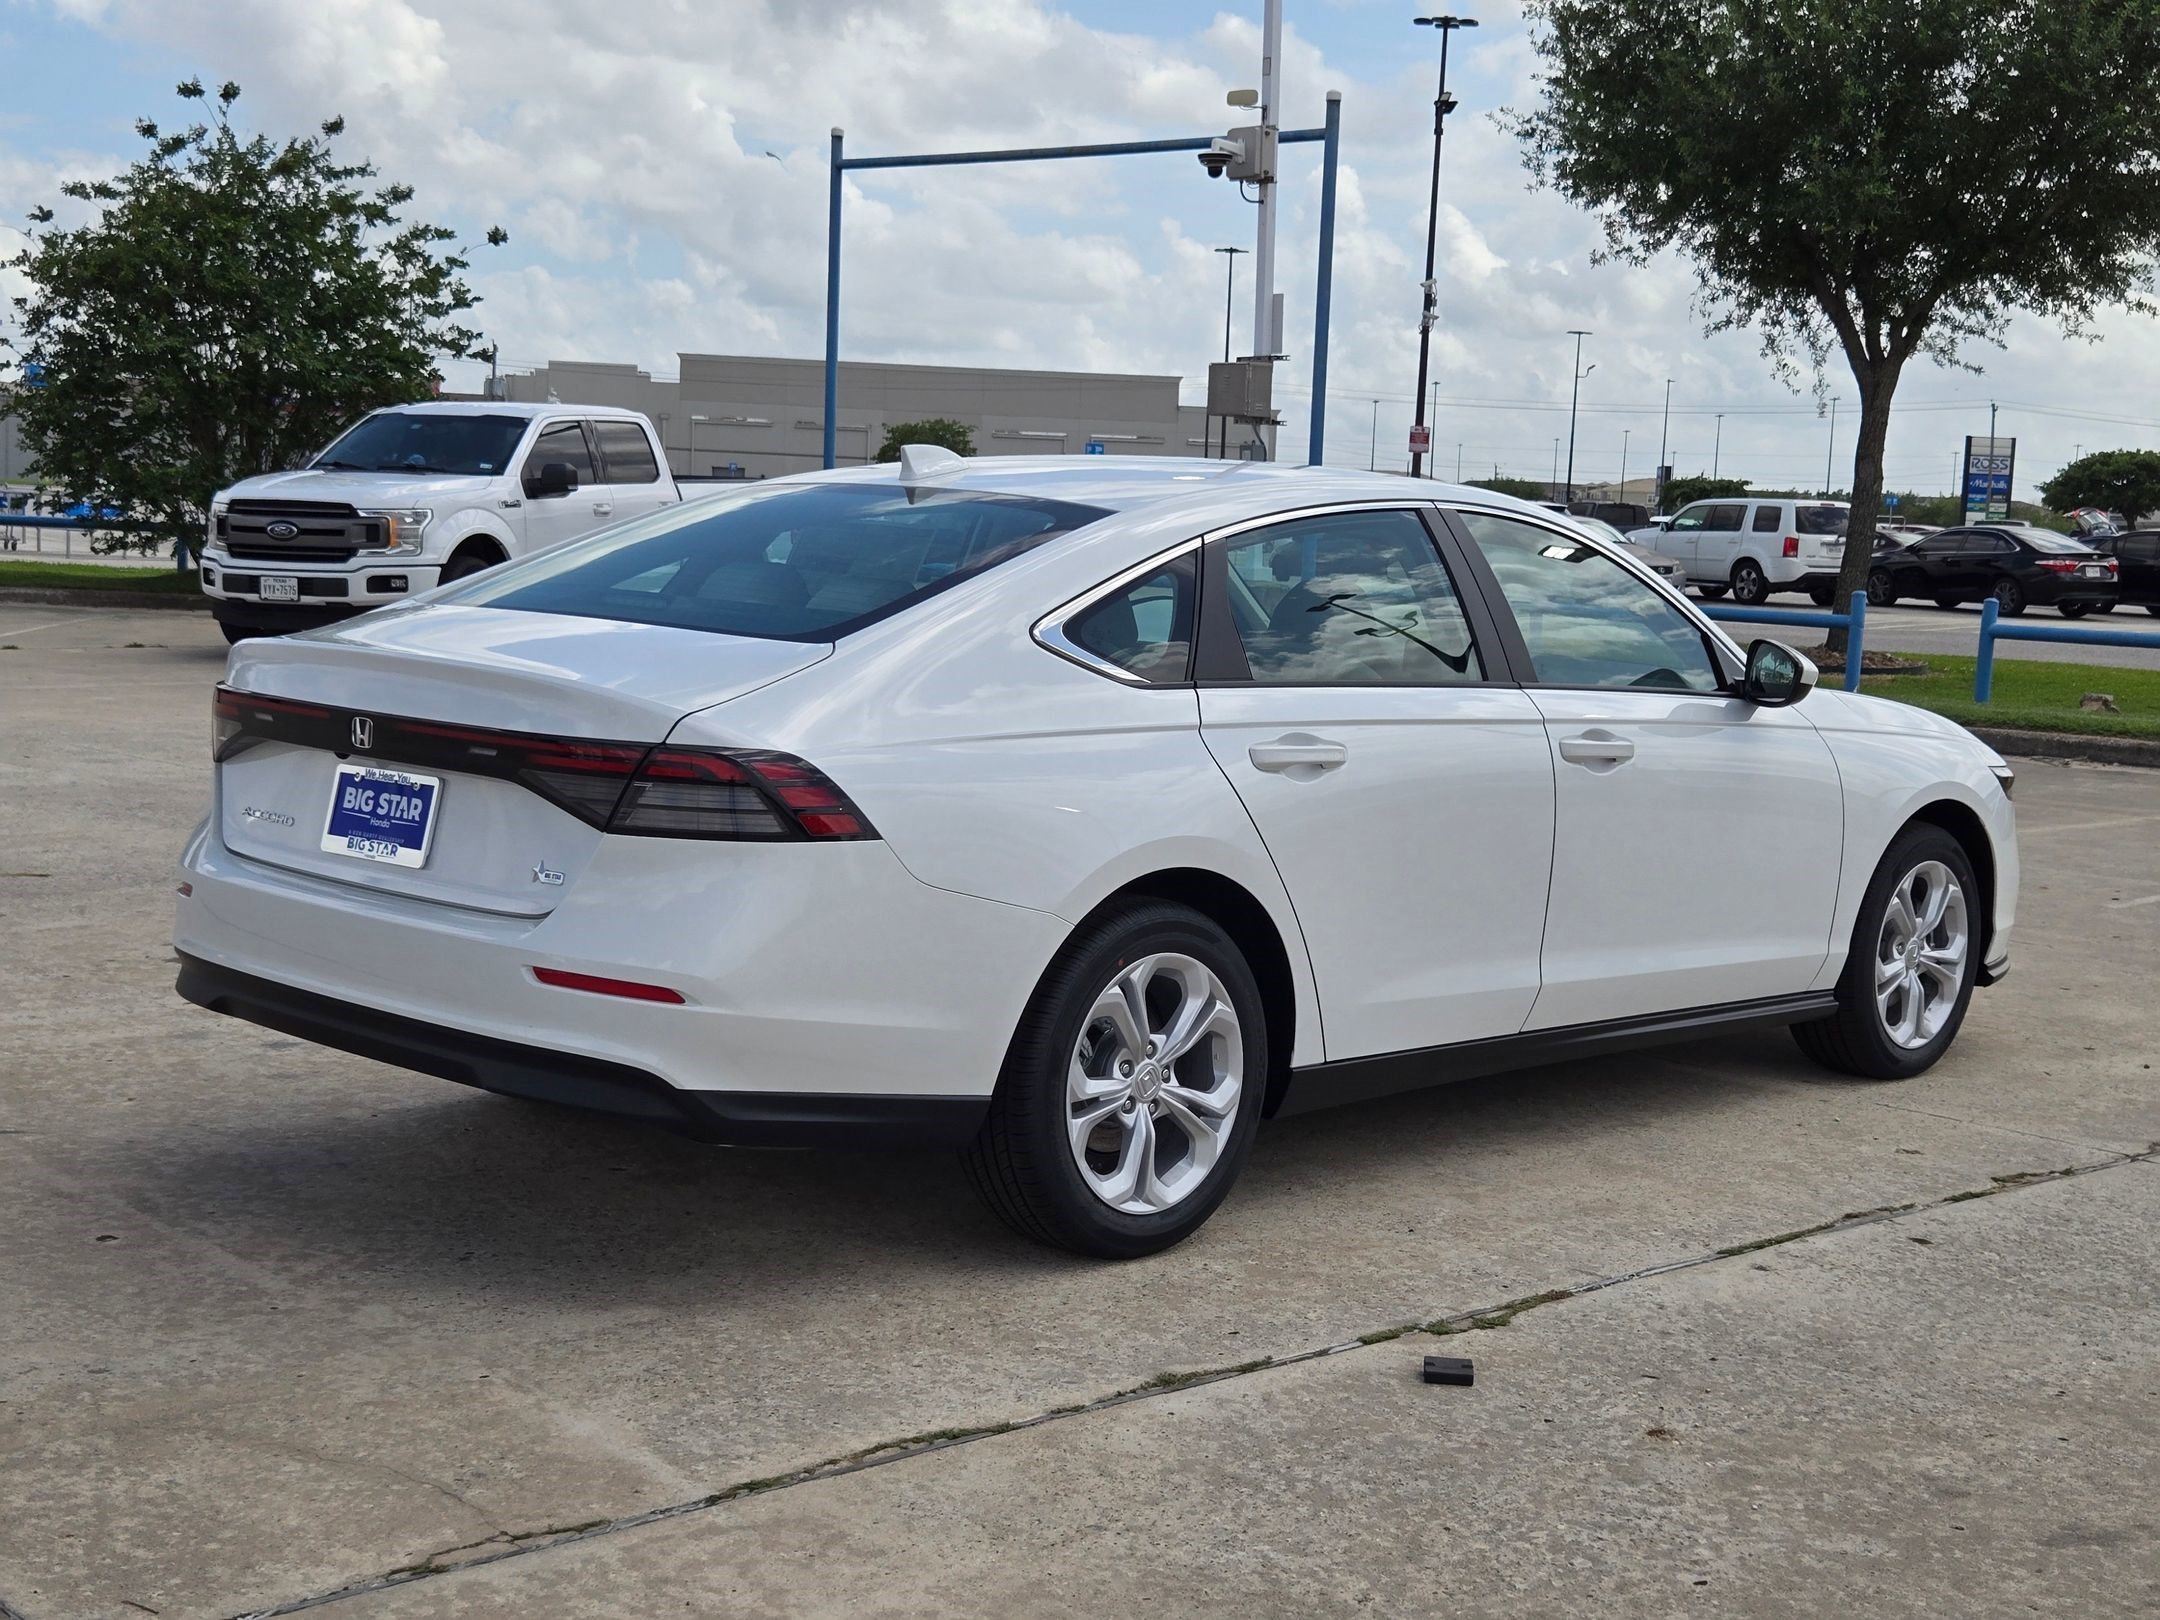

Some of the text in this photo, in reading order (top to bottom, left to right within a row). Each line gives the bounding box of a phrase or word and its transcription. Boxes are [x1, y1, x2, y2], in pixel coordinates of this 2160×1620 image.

[1971, 457, 2009, 470] ROSS
[365, 768, 411, 784] We Hear You
[343, 786, 423, 821] BIG STAR
[370, 817, 391, 828] Honda
[347, 837, 366, 850] BIG
[367, 840, 398, 857] STAR
